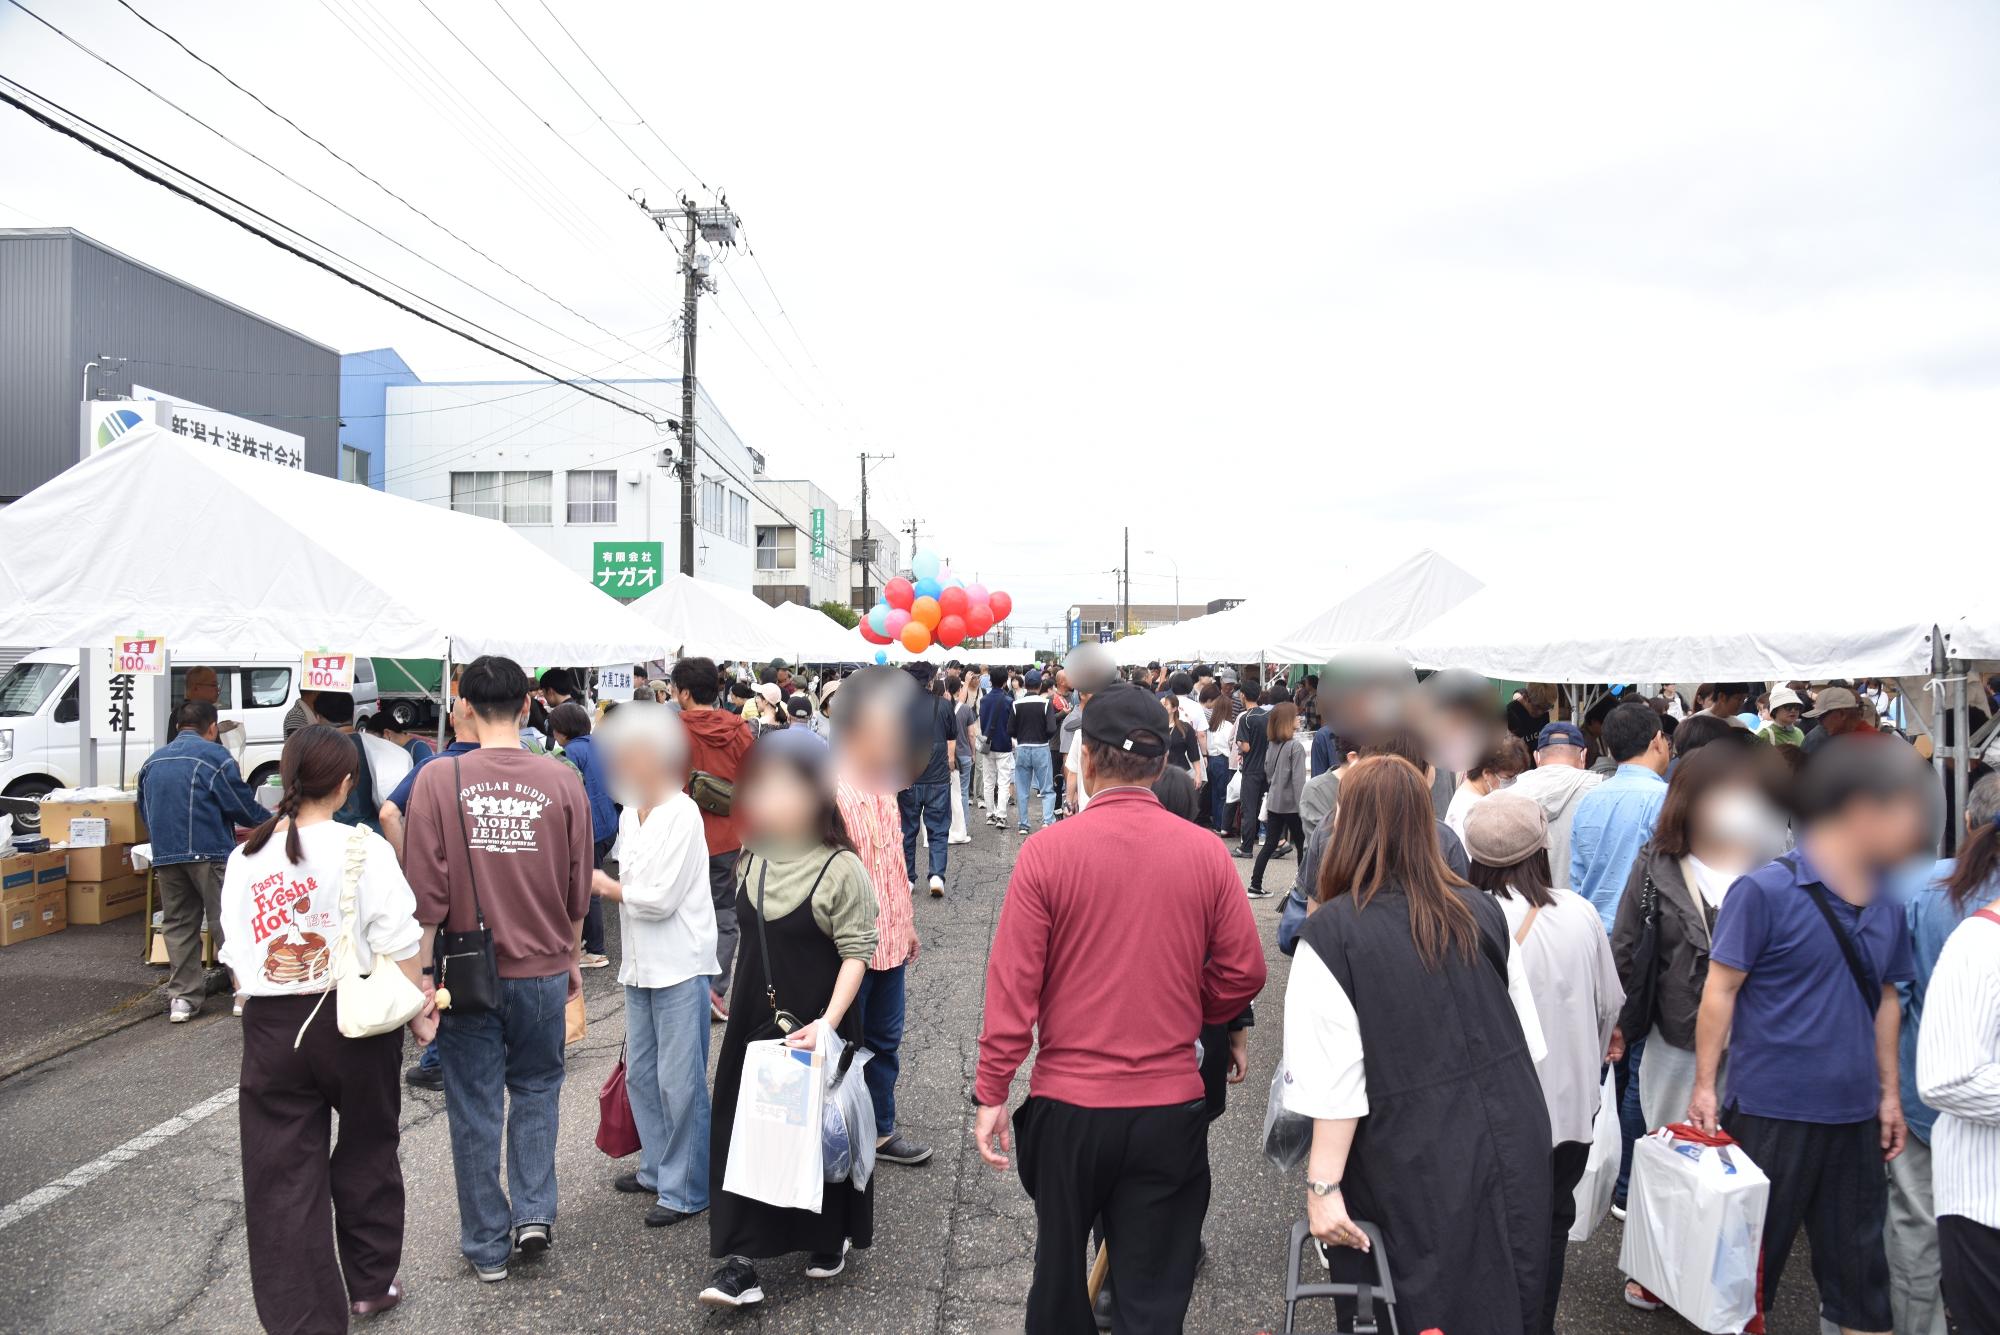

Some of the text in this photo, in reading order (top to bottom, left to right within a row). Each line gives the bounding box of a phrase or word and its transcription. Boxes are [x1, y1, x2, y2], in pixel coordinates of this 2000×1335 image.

[172, 414, 302, 470] 新潟大洋株式会社
[602, 551, 652, 562] 有限会社
[597, 566, 657, 587] ナガオ
[129, 642, 150, 653] 全品
[318, 658, 339, 669] 全品
[515, 783, 553, 807] BUDDY
[472, 828, 536, 840] FELLOW
[477, 817, 531, 830] NOBLE
[251, 871, 284, 896] Tasty
[254, 880, 308, 917] Fresh
[251, 908, 291, 944] Hot
